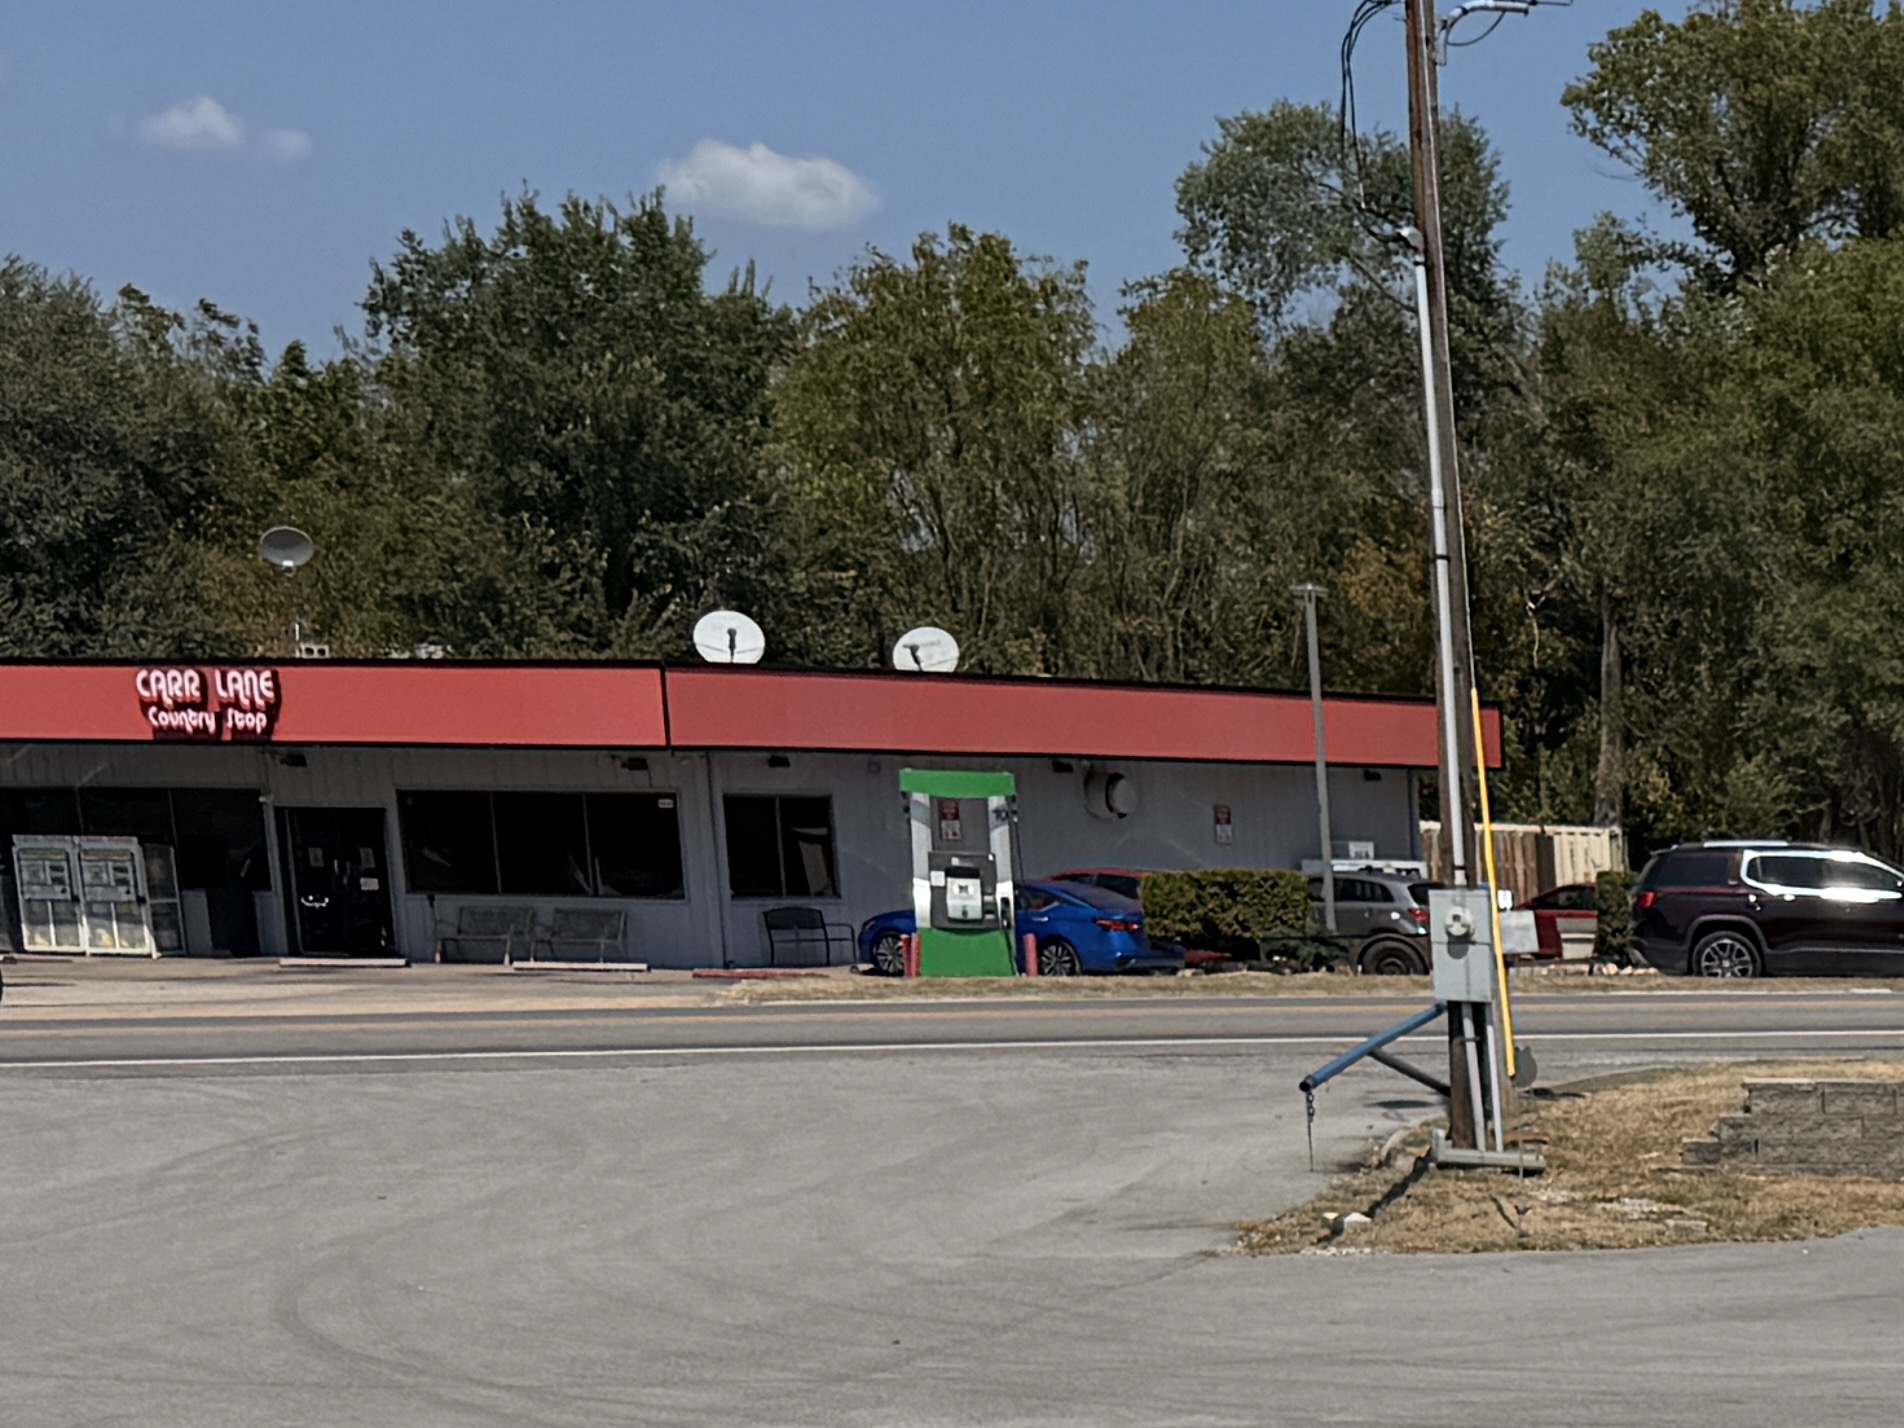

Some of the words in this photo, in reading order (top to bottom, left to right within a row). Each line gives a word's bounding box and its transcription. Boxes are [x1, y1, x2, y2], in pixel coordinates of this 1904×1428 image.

[136, 669, 201, 709] CARR
[214, 669, 275, 710] LANE
[148, 706, 216, 734] Country
[227, 707, 267, 734] Stop
